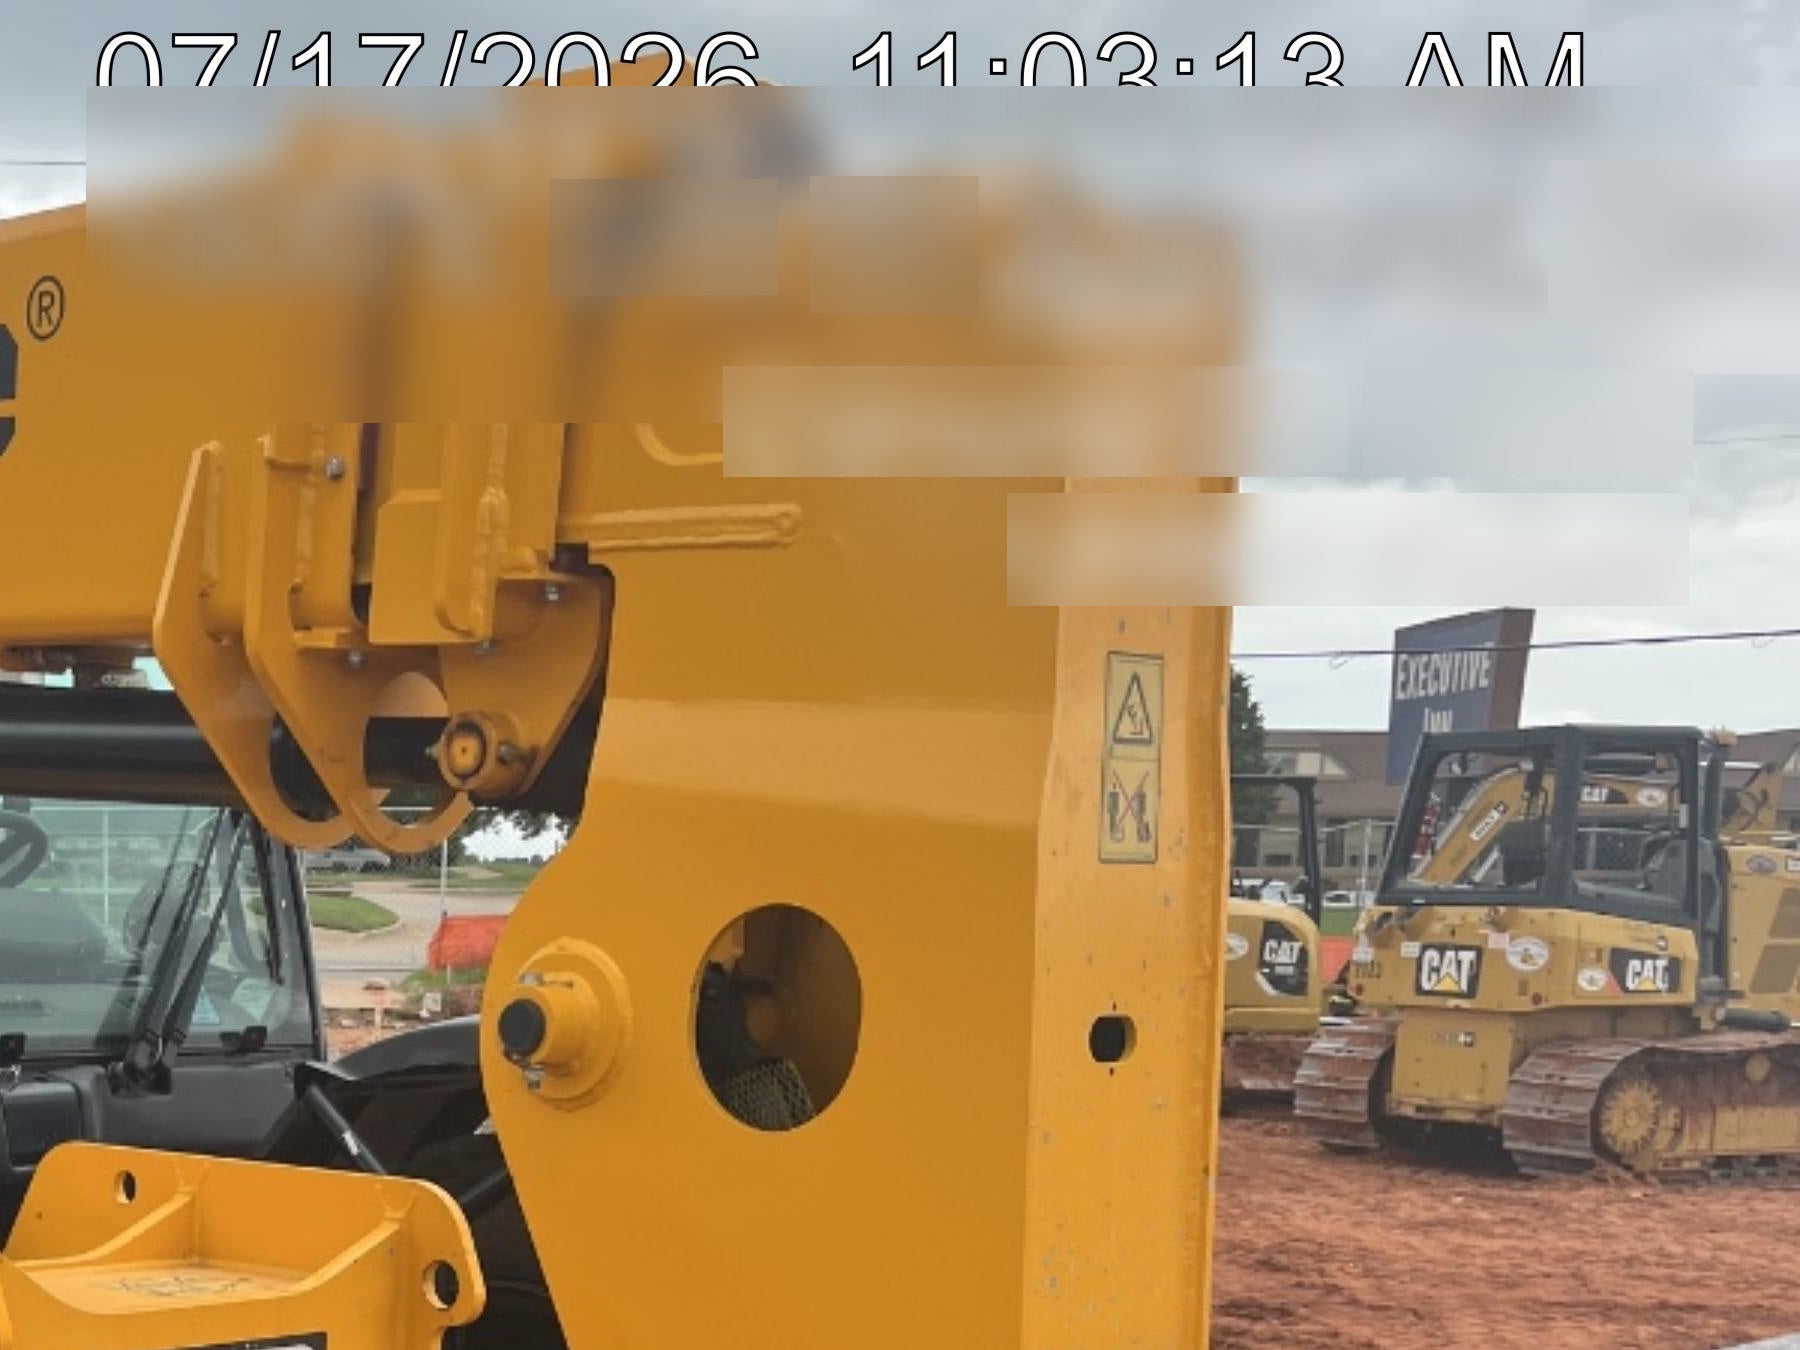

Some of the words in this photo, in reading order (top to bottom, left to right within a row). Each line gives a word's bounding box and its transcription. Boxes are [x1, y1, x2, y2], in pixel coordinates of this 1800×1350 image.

[1395, 652, 1492, 700] EXECUTIVE
[1263, 939, 1303, 964] CAT
[1420, 947, 1478, 992] CAT
[1625, 957, 1669, 992] CAT
